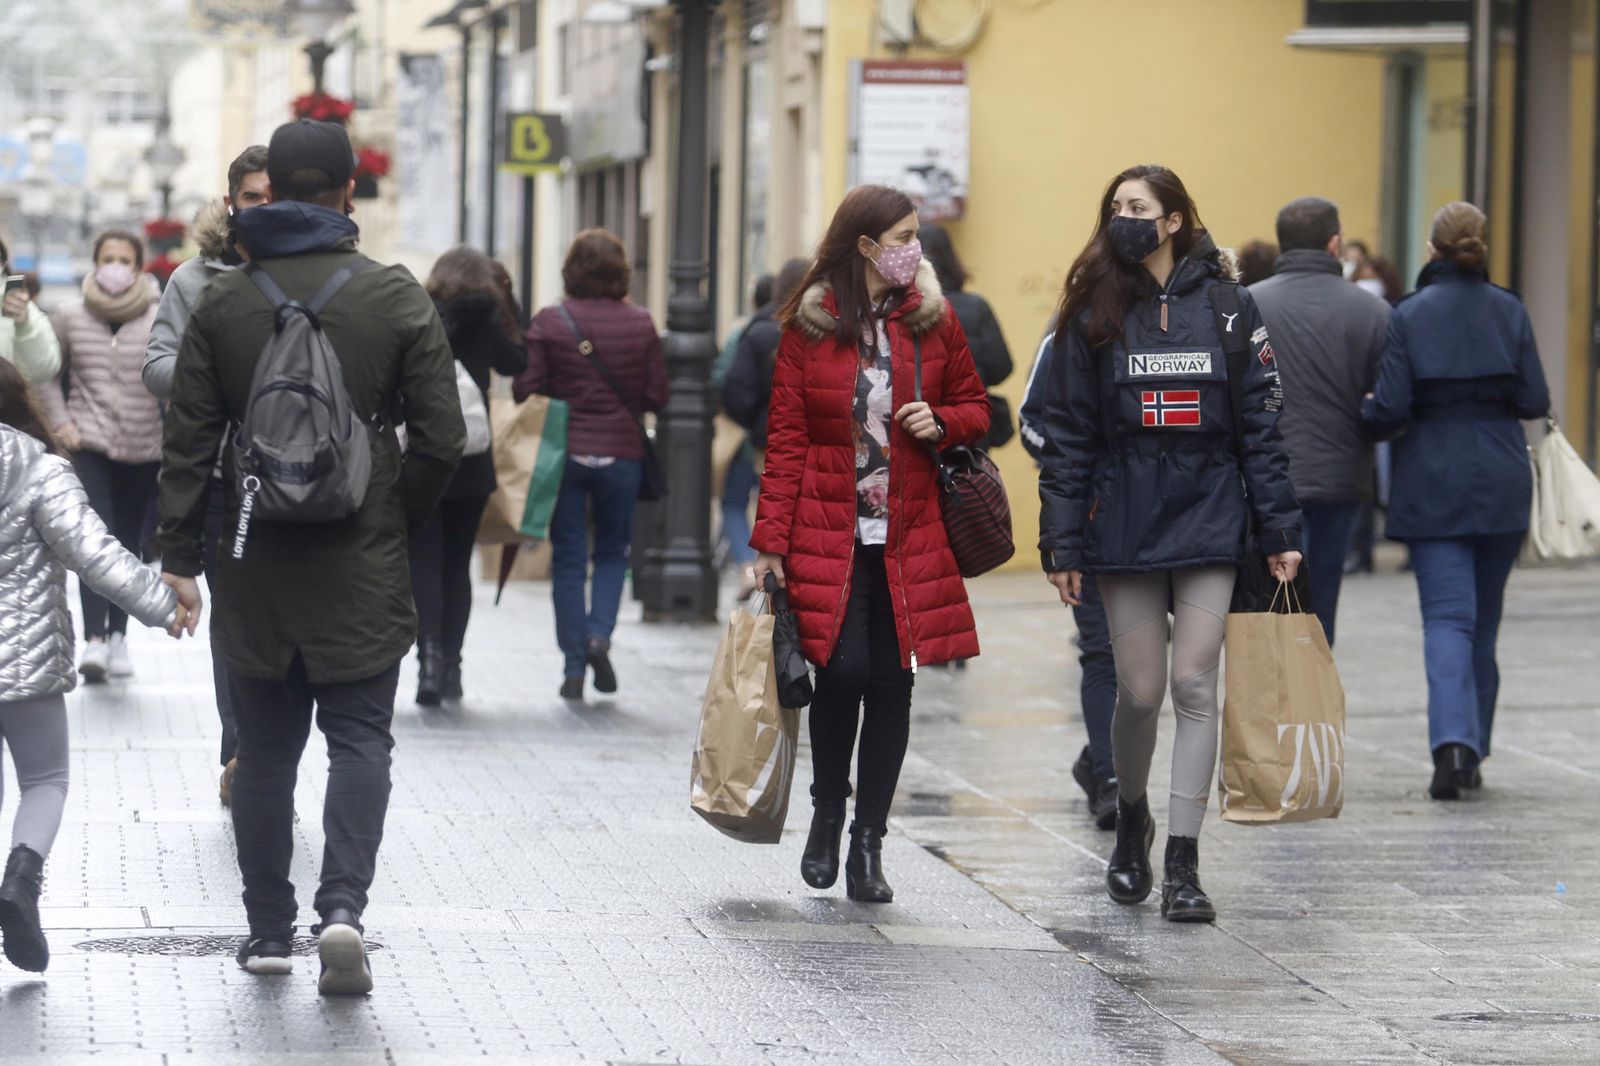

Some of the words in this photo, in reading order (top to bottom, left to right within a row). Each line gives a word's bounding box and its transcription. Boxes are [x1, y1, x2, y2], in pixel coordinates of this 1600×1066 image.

[512, 115, 551, 160] B
[1131, 355, 1206, 374] NORWAY
[237, 512, 250, 534] LOVE
[233, 536, 245, 558] LOVE
